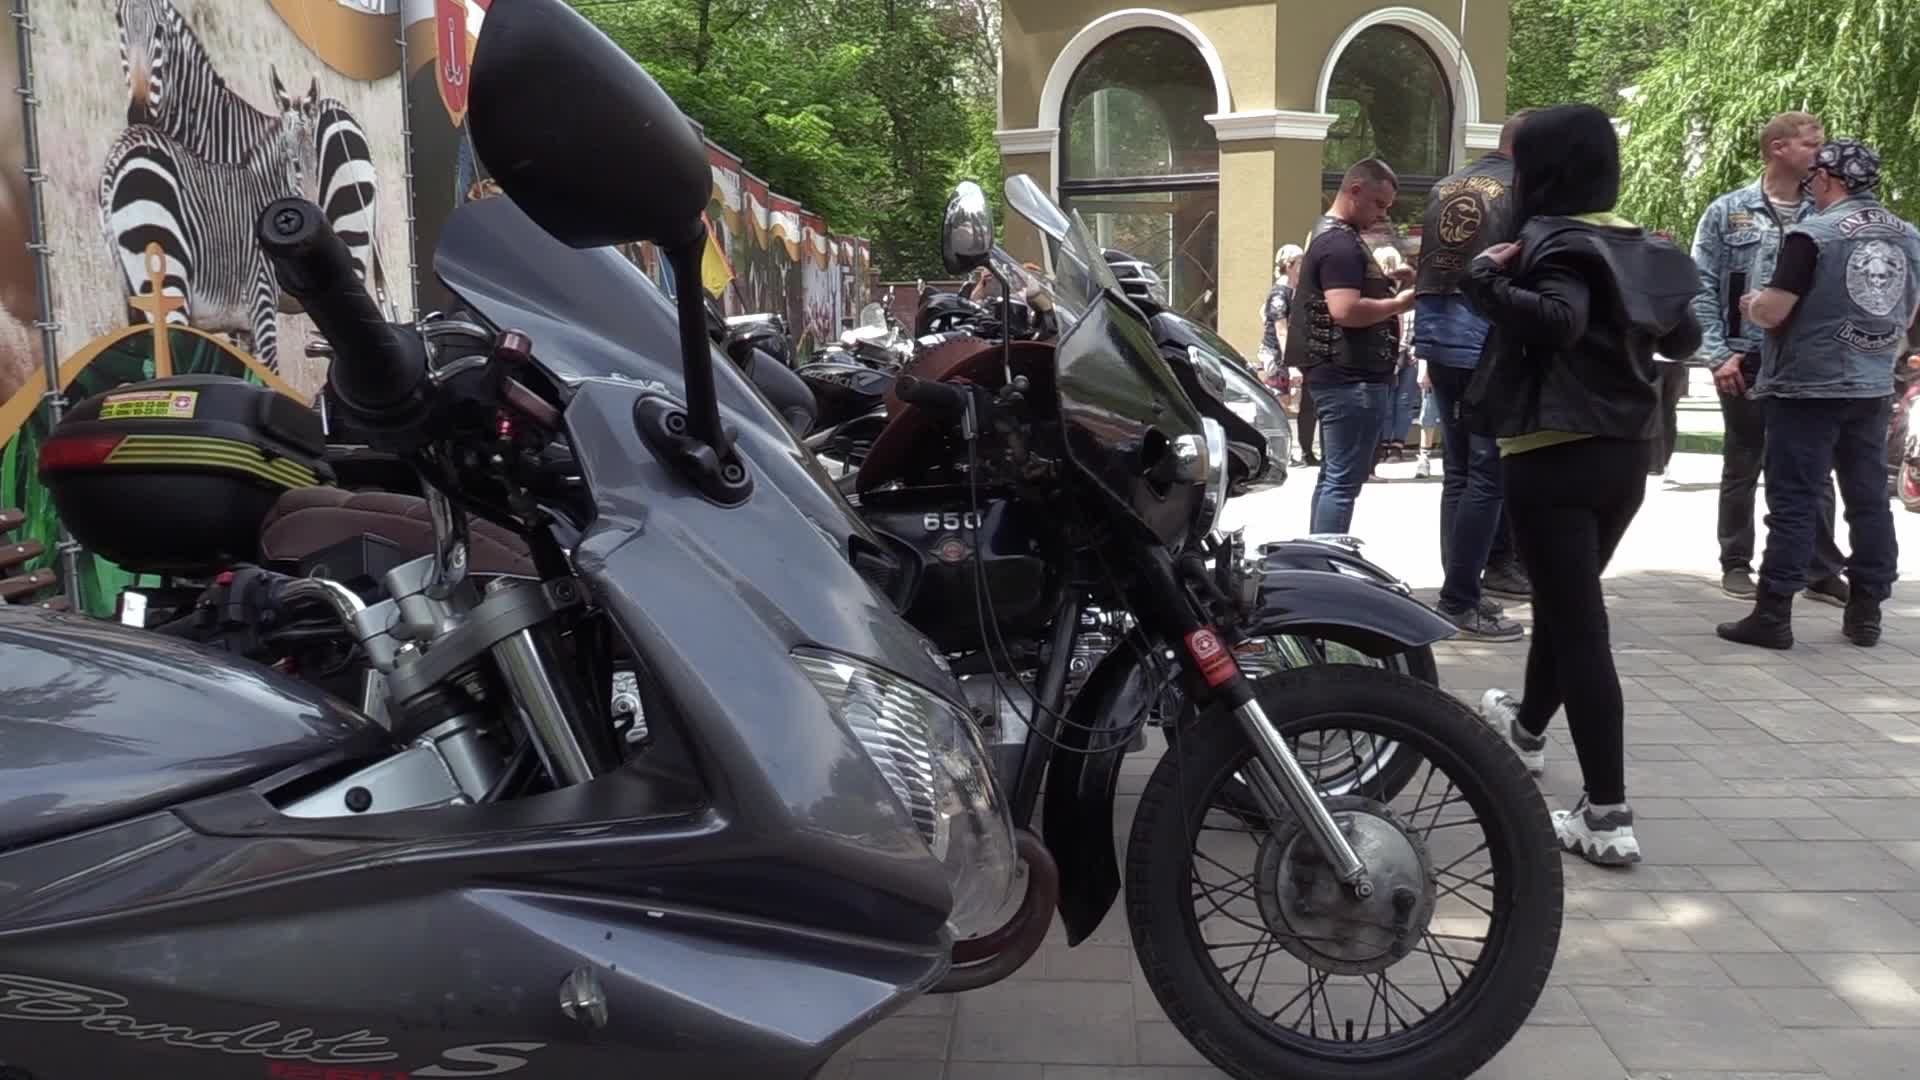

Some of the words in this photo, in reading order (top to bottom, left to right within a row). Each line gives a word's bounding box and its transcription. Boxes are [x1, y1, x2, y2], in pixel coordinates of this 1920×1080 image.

[1839, 212, 1868, 233] ONE
[801, 367, 850, 389] SUZUKI
[923, 512, 982, 531] 650
[0, 974, 398, 1063] Bandit
[409, 1042, 548, 1077] S
